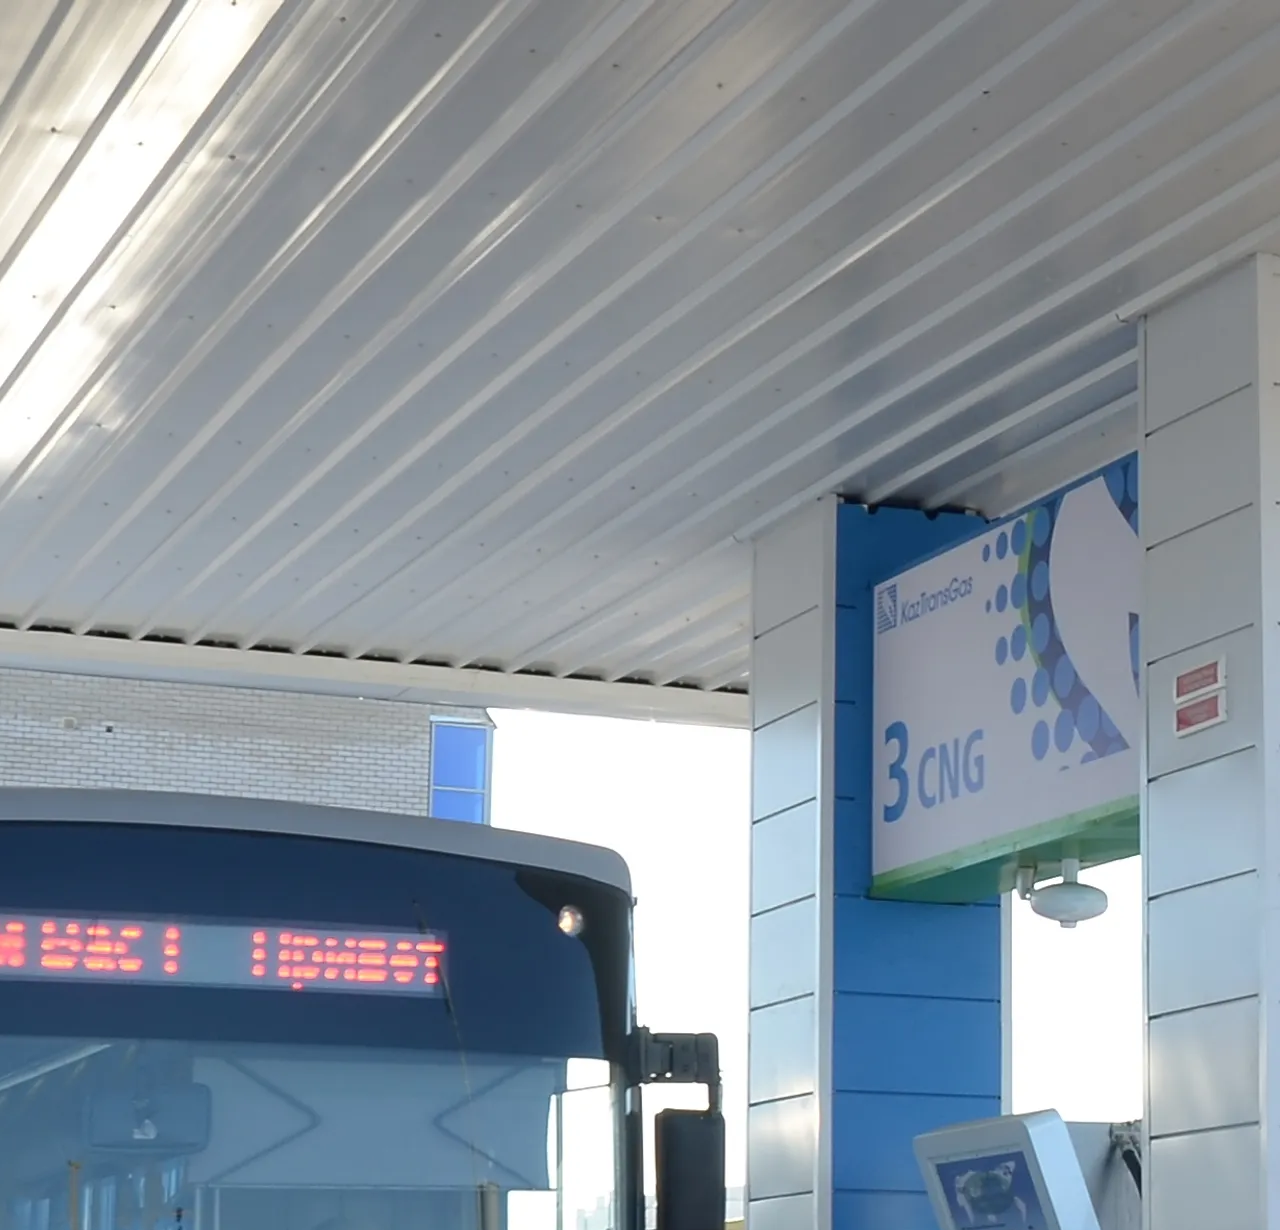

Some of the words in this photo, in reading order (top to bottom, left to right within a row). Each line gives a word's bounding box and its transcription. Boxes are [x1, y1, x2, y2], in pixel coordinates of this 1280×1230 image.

[899, 576, 974, 626] KazTransGas
[883, 720, 910, 824] 3
[917, 728, 986, 810] CNG
